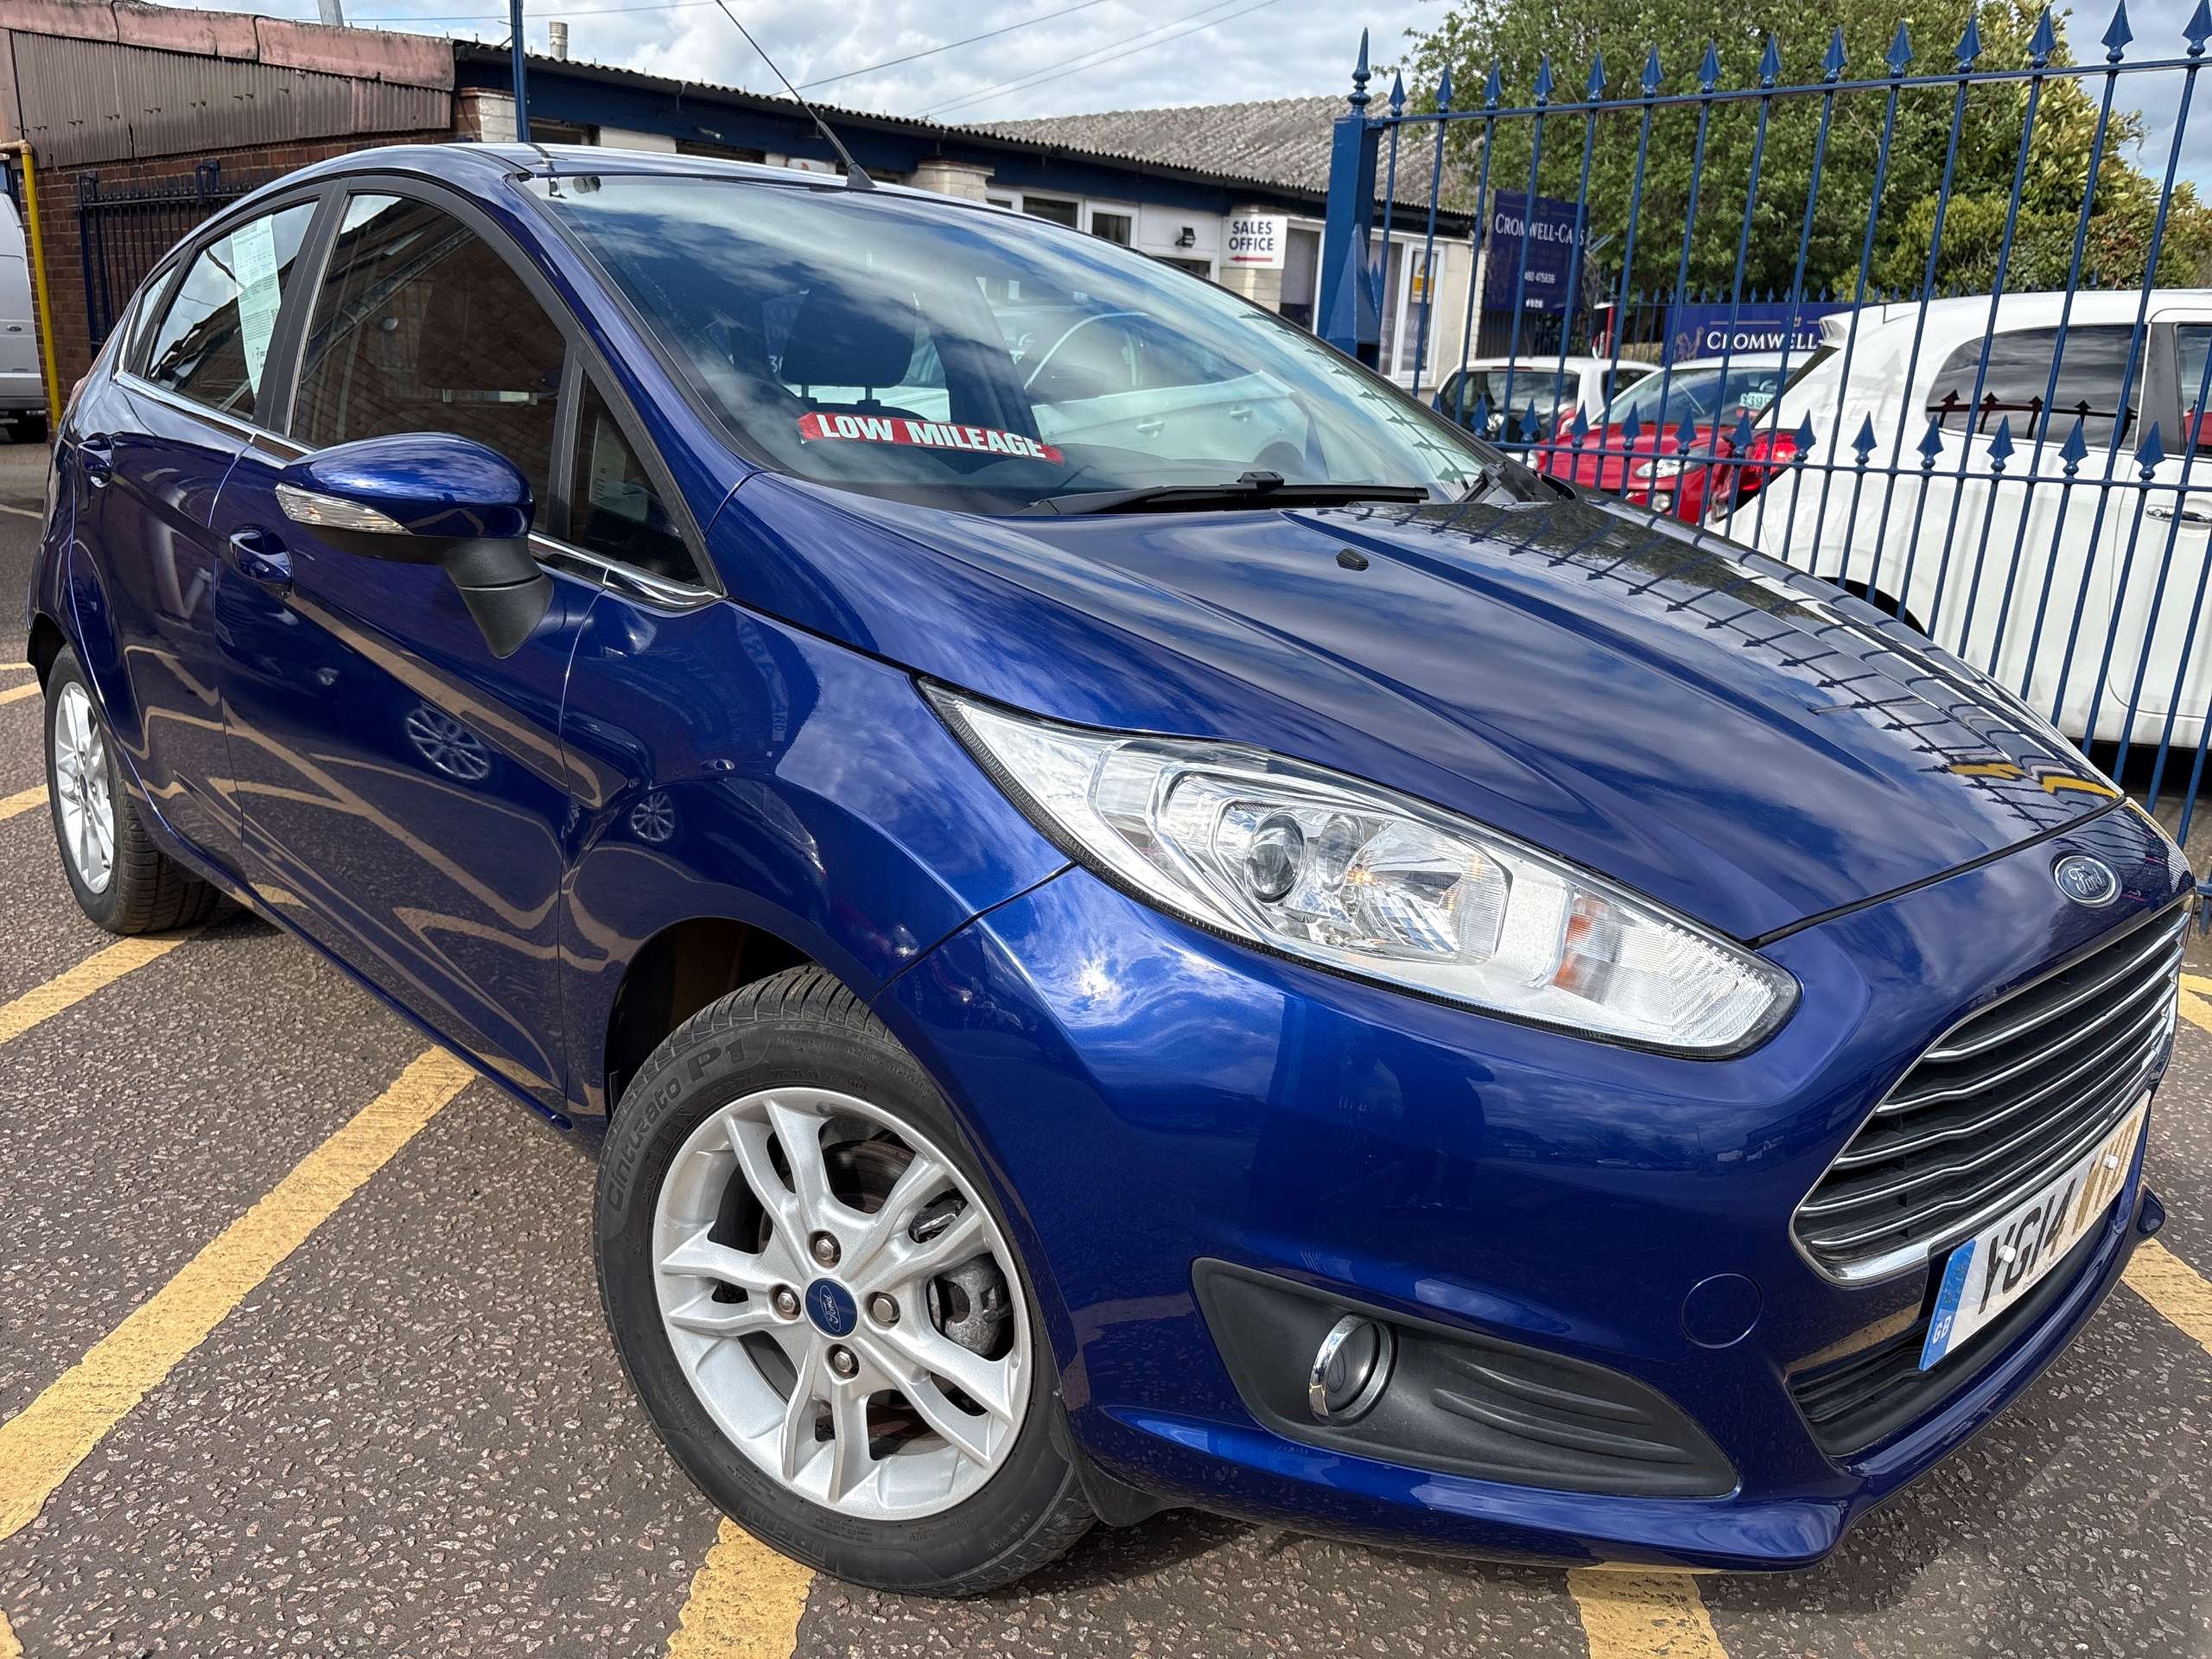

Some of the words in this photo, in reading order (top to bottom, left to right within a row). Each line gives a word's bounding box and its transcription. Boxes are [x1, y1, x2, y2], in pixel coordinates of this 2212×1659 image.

[1232, 220, 1272, 234] SALES
[1495, 213, 1585, 245] CROMWELL-CAS
[1229, 237, 1274, 251] OFFICE
[817, 414, 893, 442] LOW
[906, 421, 1046, 458] MILEAGE
[2068, 866, 2106, 895] Ford
[688, 1039, 745, 1082] P1
[822, 1293, 839, 1325] Ford
[1932, 1314, 1953, 1344] GB
